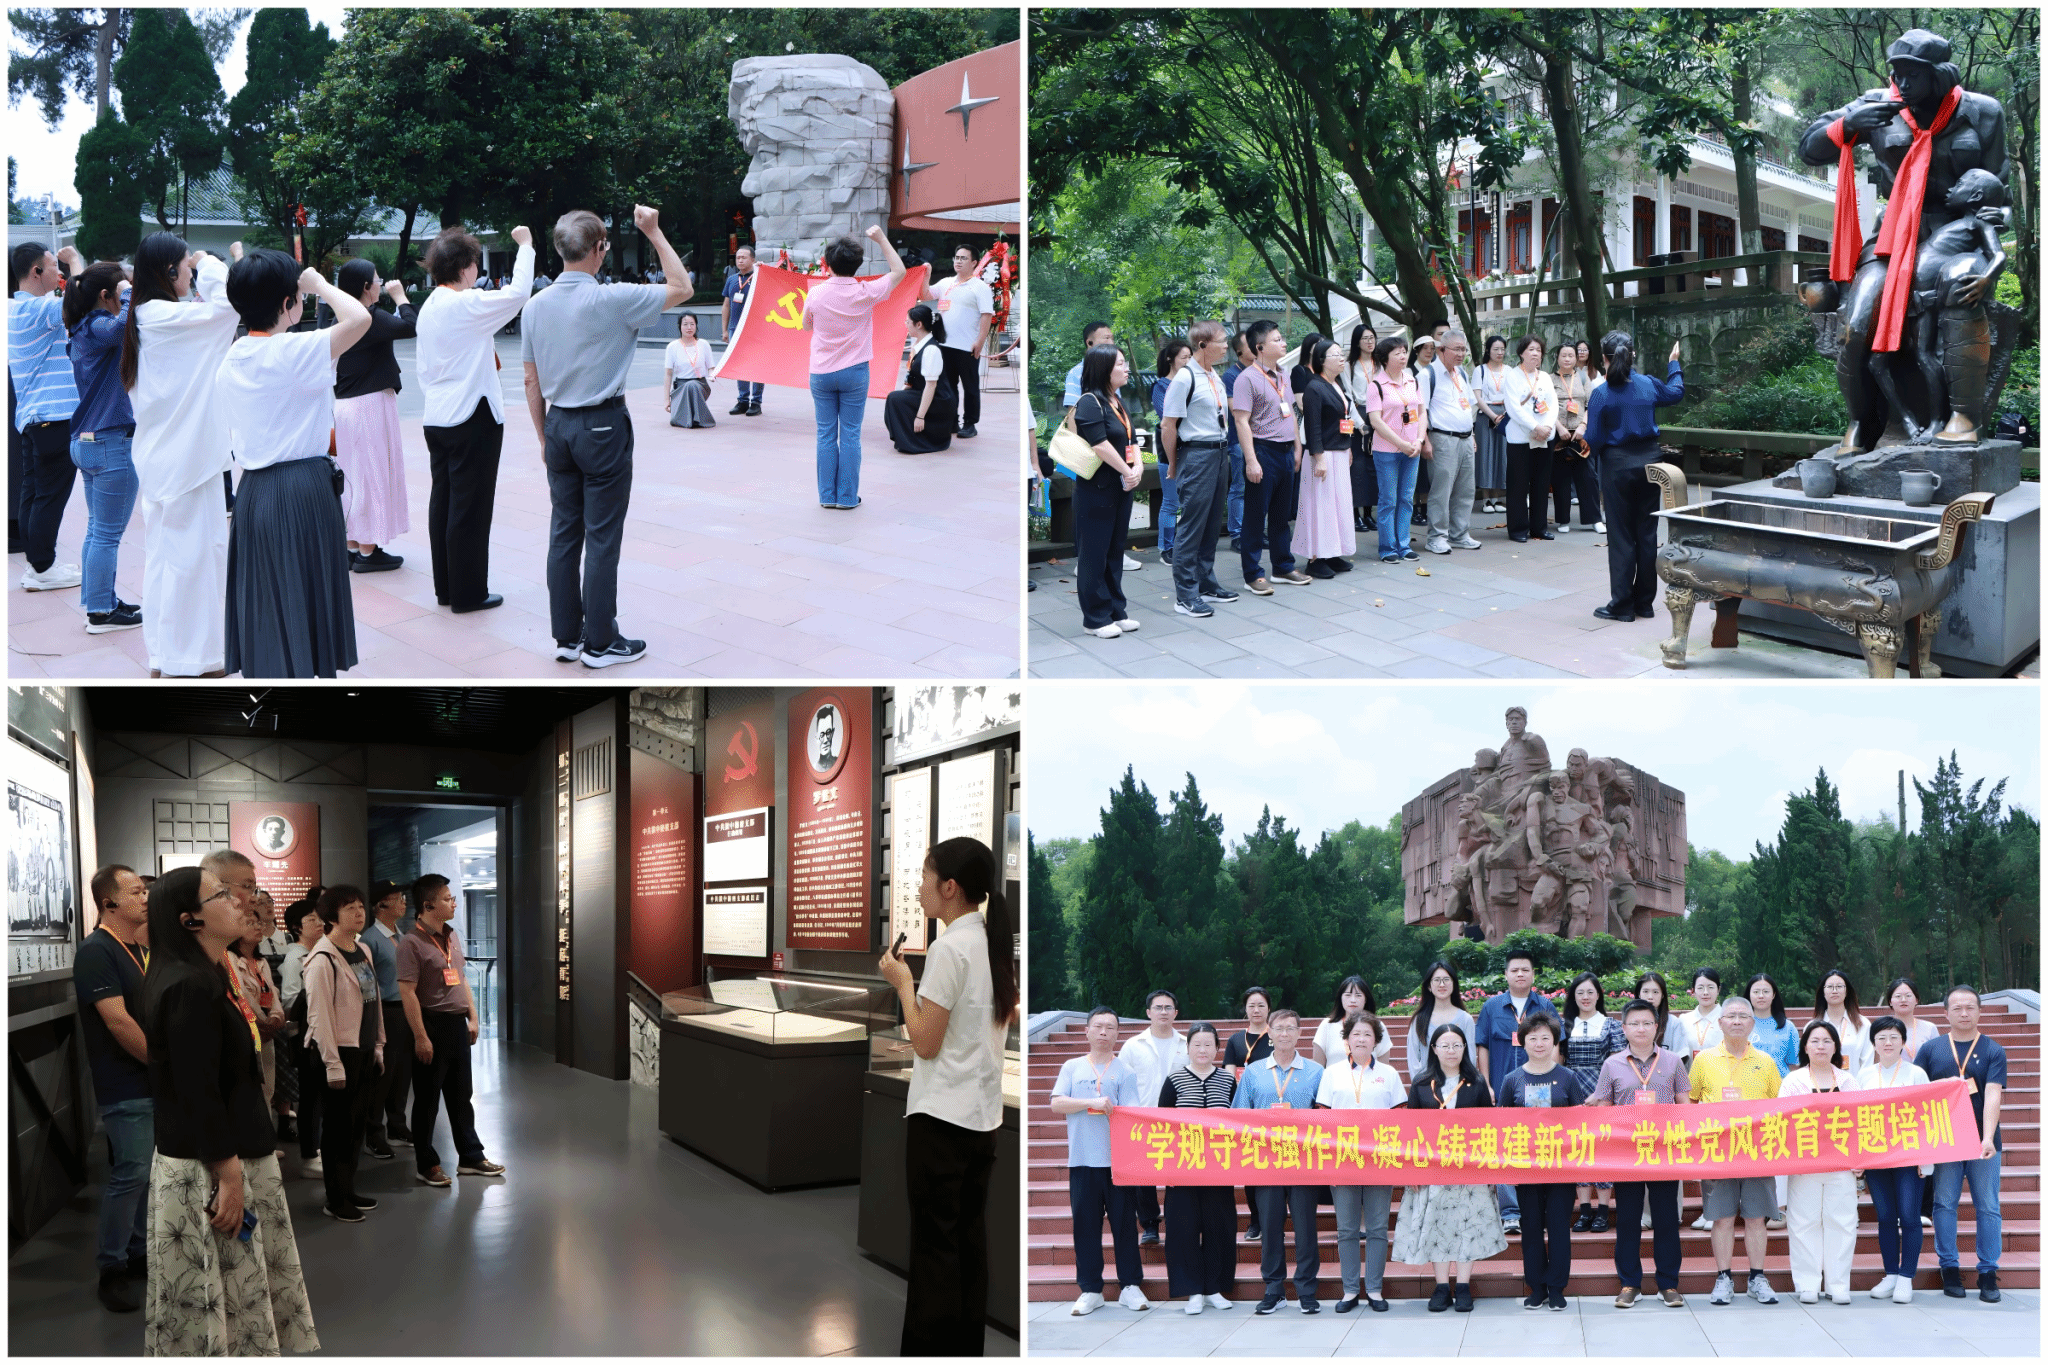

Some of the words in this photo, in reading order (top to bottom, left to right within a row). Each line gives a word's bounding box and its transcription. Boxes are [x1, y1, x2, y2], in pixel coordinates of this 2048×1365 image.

[1130, 1122, 1366, 1171] “学规守纪强作风
[1372, 1122, 1612, 1170] 凝心铸魂建新功”
[1631, 1097, 1956, 1166] 党性党风教育专题培训
